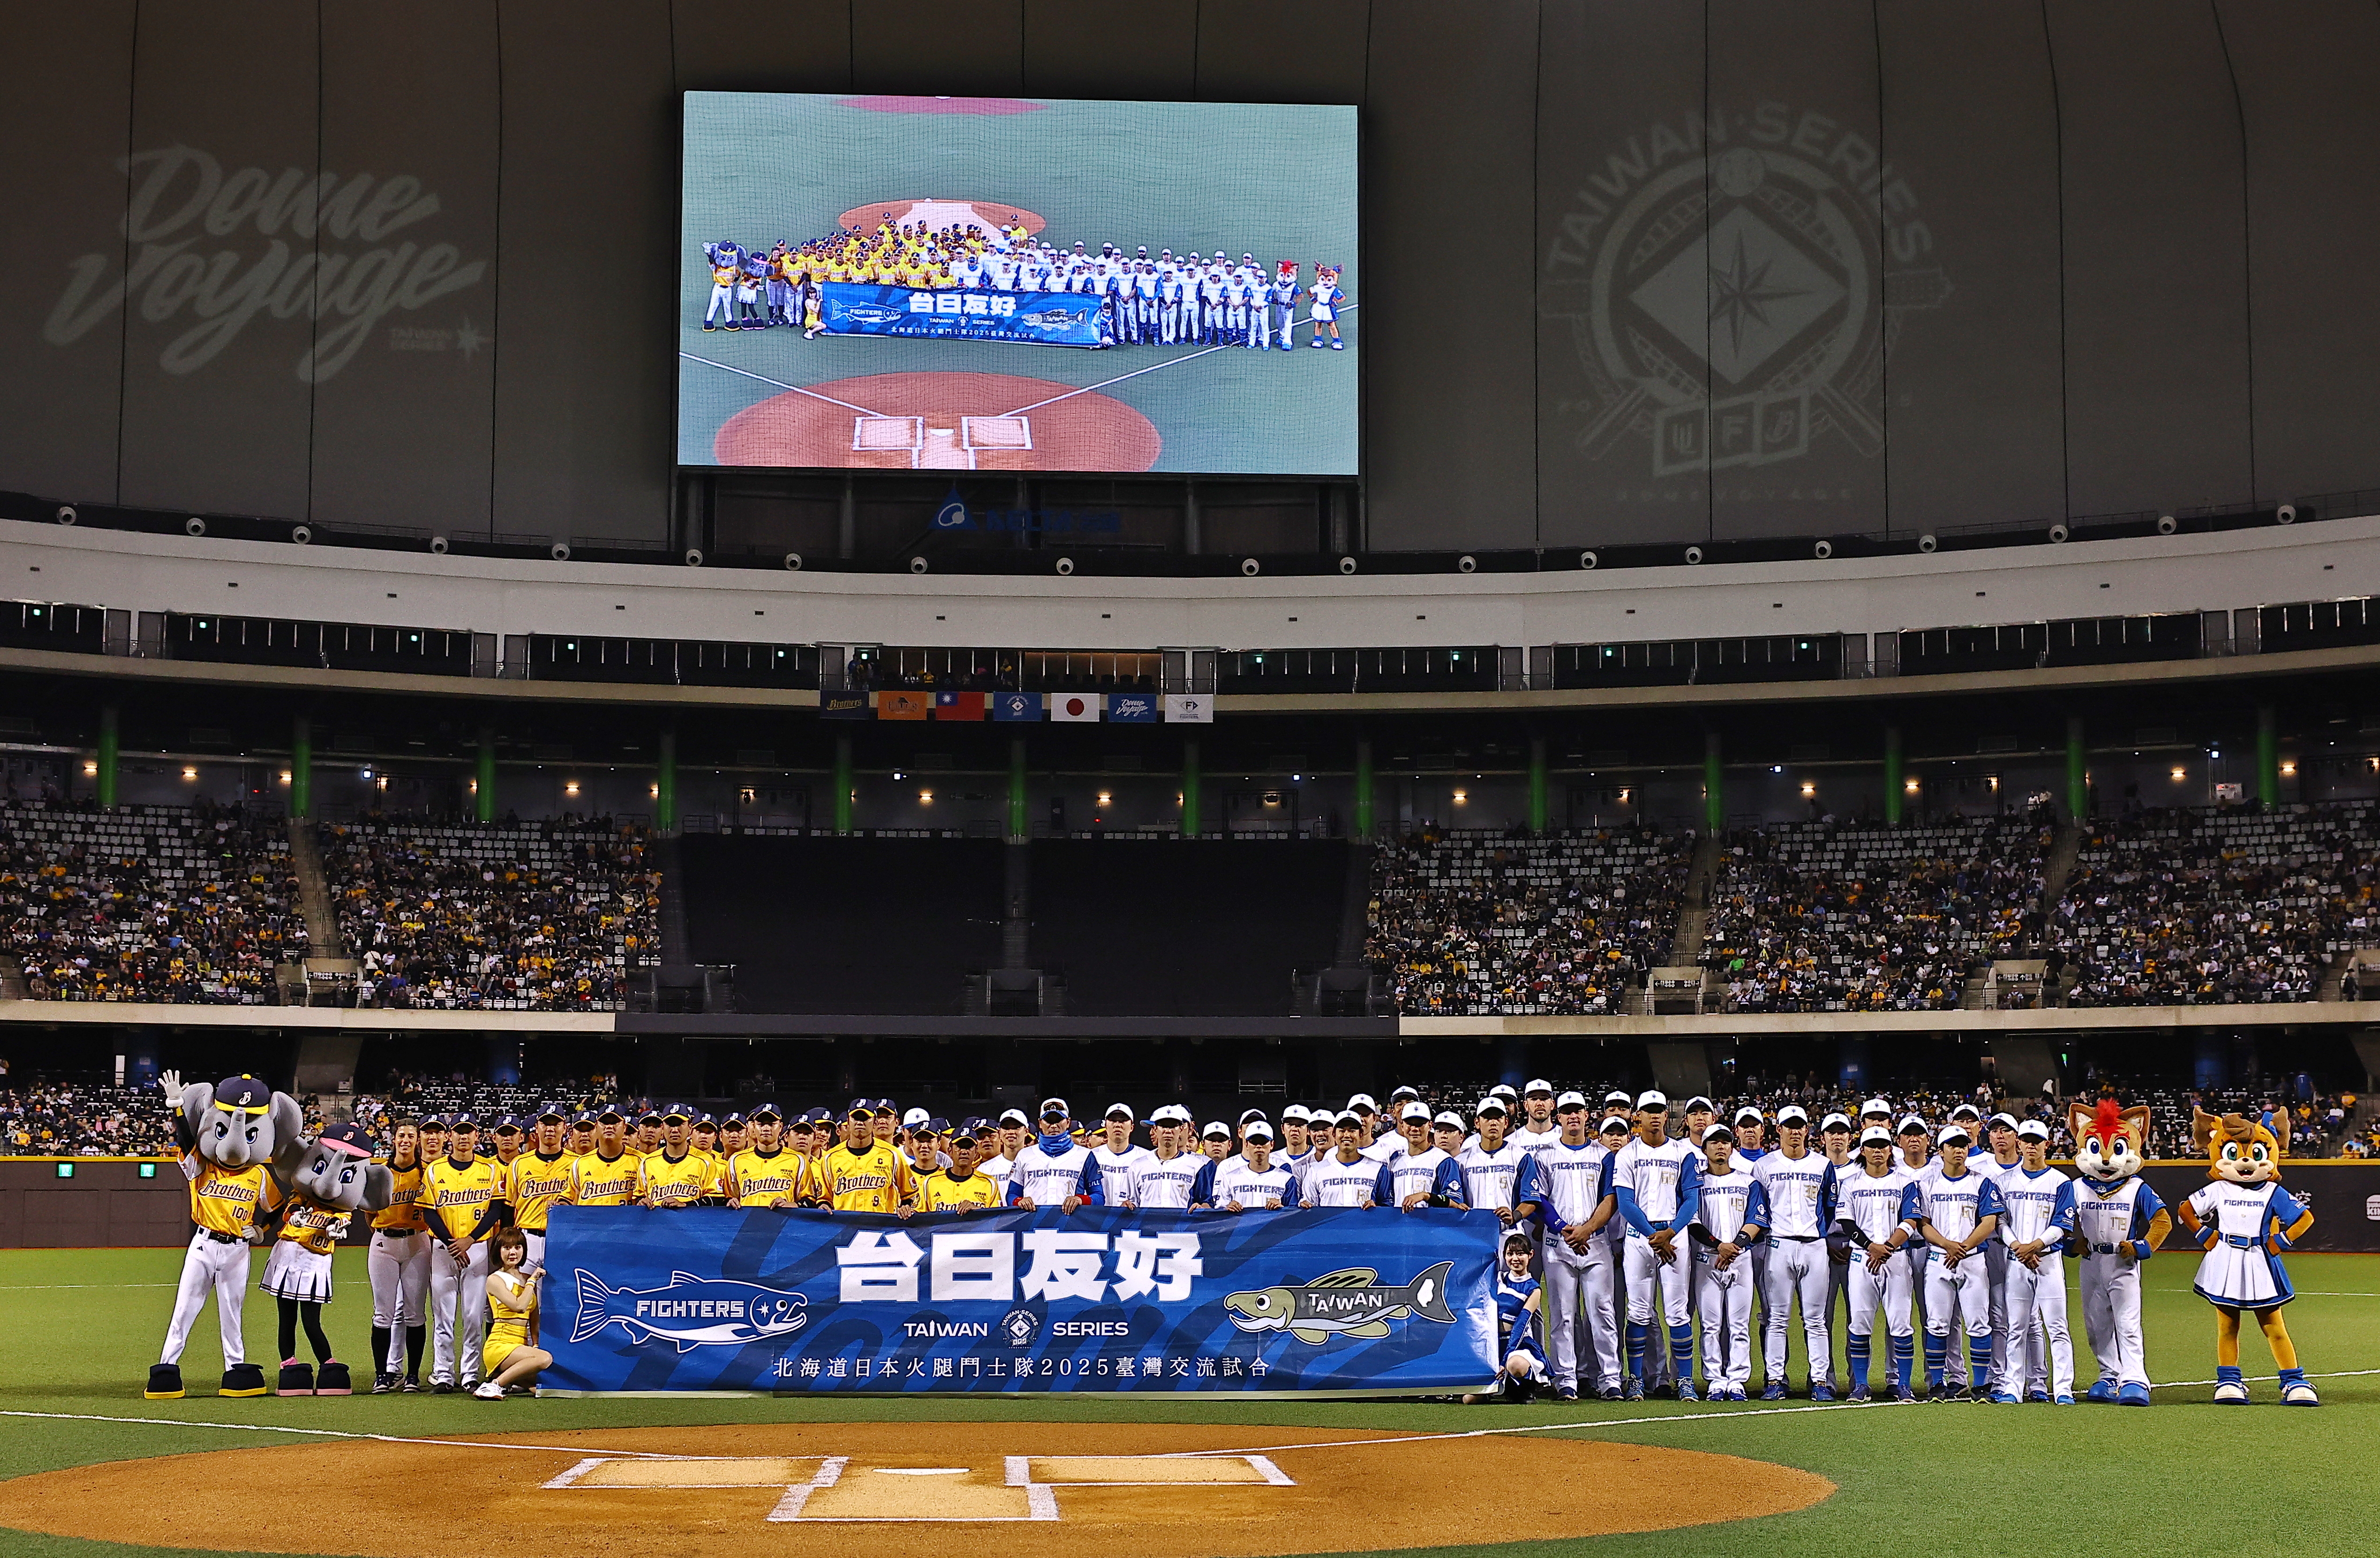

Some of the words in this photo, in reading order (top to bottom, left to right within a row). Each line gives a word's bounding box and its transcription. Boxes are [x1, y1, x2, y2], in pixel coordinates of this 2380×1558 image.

[115, 143, 440, 242] Dome
[43, 235, 487, 383] Voyage
[908, 292, 1016, 317] 台日友好
[1028, 1169, 1079, 1179] FIGHTERS
[1465, 1165, 1515, 1175] FIGHTERS
[1551, 1162, 1601, 1172] FIGHTERS
[1141, 1172, 1193, 1182] FIGHTERS
[1323, 1178, 1375, 1187] FIGHTERS
[1770, 1172, 1823, 1183] FIGHTERS
[198, 1180, 256, 1202] Brothers
[580, 1177, 636, 1200] Brothers
[741, 1177, 792, 1197] Brothers
[834, 1174, 887, 1195] Brothers
[1177, 1184, 1185, 1197] 7
[1233, 1184, 1285, 1196] FIGHTERS
[437, 1188, 491, 1206] Brothers
[650, 1183, 700, 1202] Brothers
[1853, 1189, 1901, 1199] FIGHTERS
[1931, 1193, 1979, 1204] FIGHTERS
[2006, 1191, 2056, 1202] FIGHTERS
[873, 1196, 879, 1207] 9
[2081, 1201, 2130, 1212] FIGHTERS
[232, 1205, 248, 1221] 100
[1627, 1228, 1640, 1237] ニトリ
[309, 1234, 329, 1248] 100
[835, 1227, 1205, 1303] 台日友好
[637, 1300, 745, 1318] FIGHTERS
[1308, 1291, 1383, 1314] TAIWAN
[904, 1319, 987, 1338] TAIWAN
[1053, 1321, 1129, 1337] SERIES
